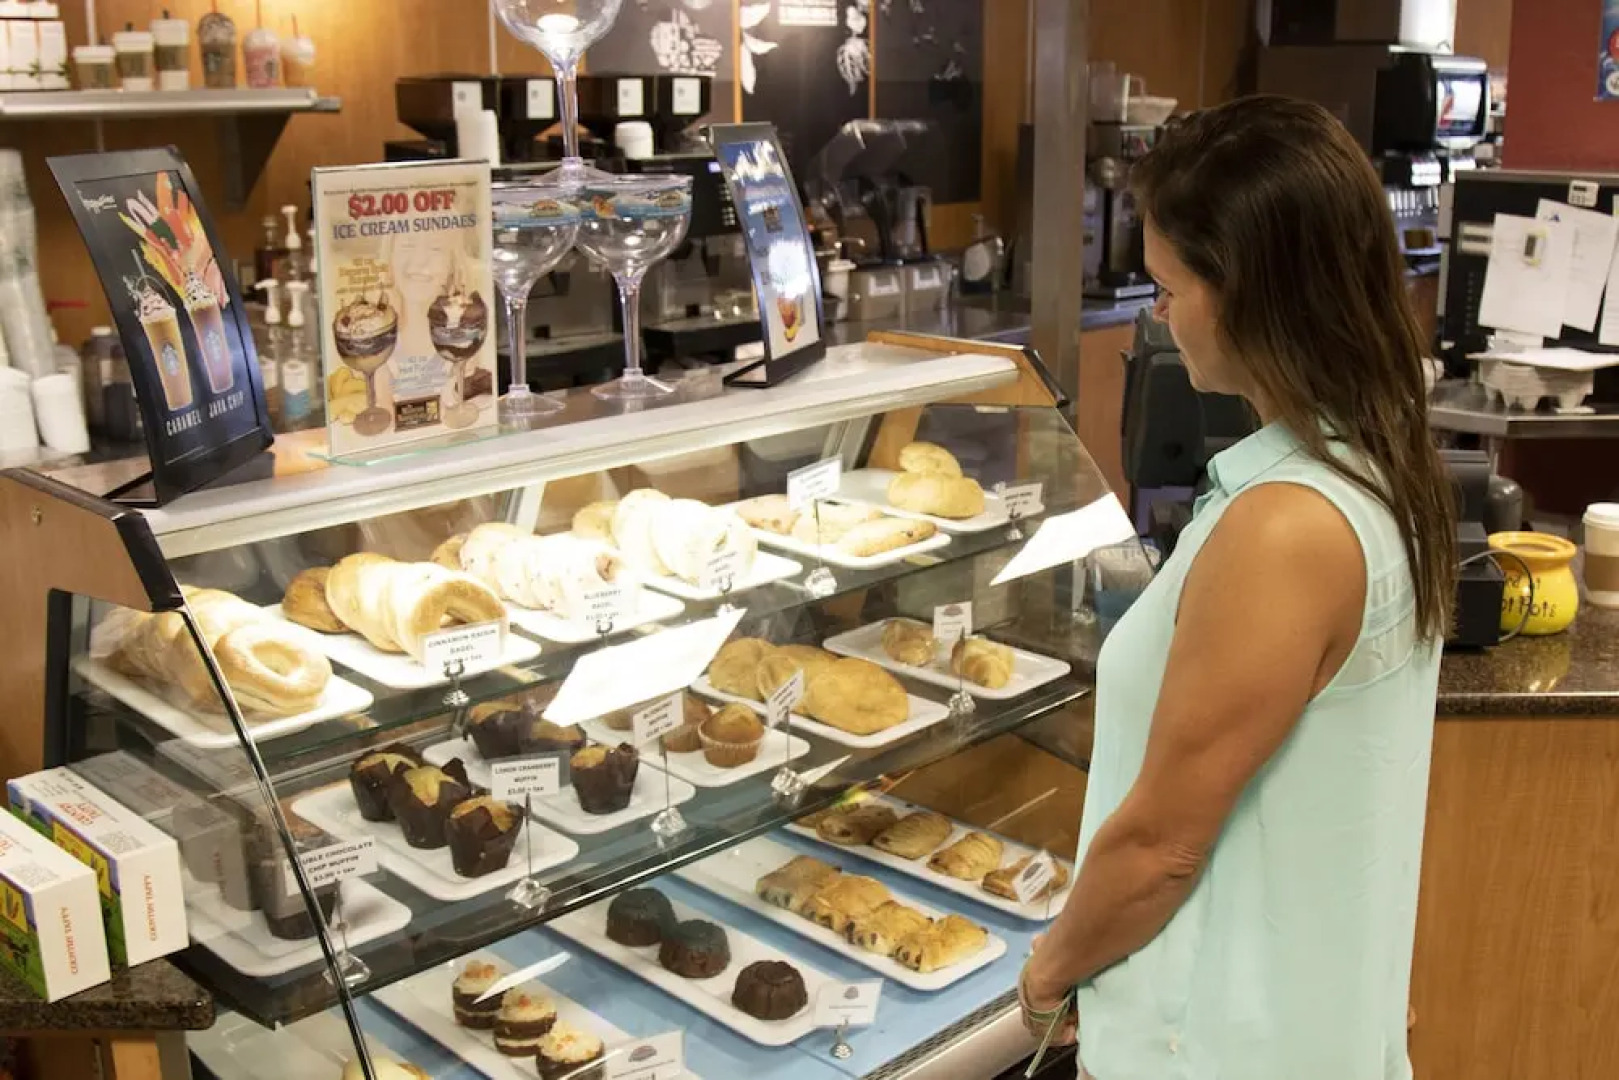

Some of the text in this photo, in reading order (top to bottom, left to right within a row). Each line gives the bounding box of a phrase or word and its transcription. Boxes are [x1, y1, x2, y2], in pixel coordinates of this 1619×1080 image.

[348, 189, 456, 219] $2.00 OFF
[334, 214, 477, 240] ICE CREAM SUNDAES
[209, 398, 228, 418] JAVA
[166, 409, 202, 437] CARAMEL
[325, 841, 373, 858] CHOCOLATE
[308, 855, 359, 874] CHIP MUFFIN
